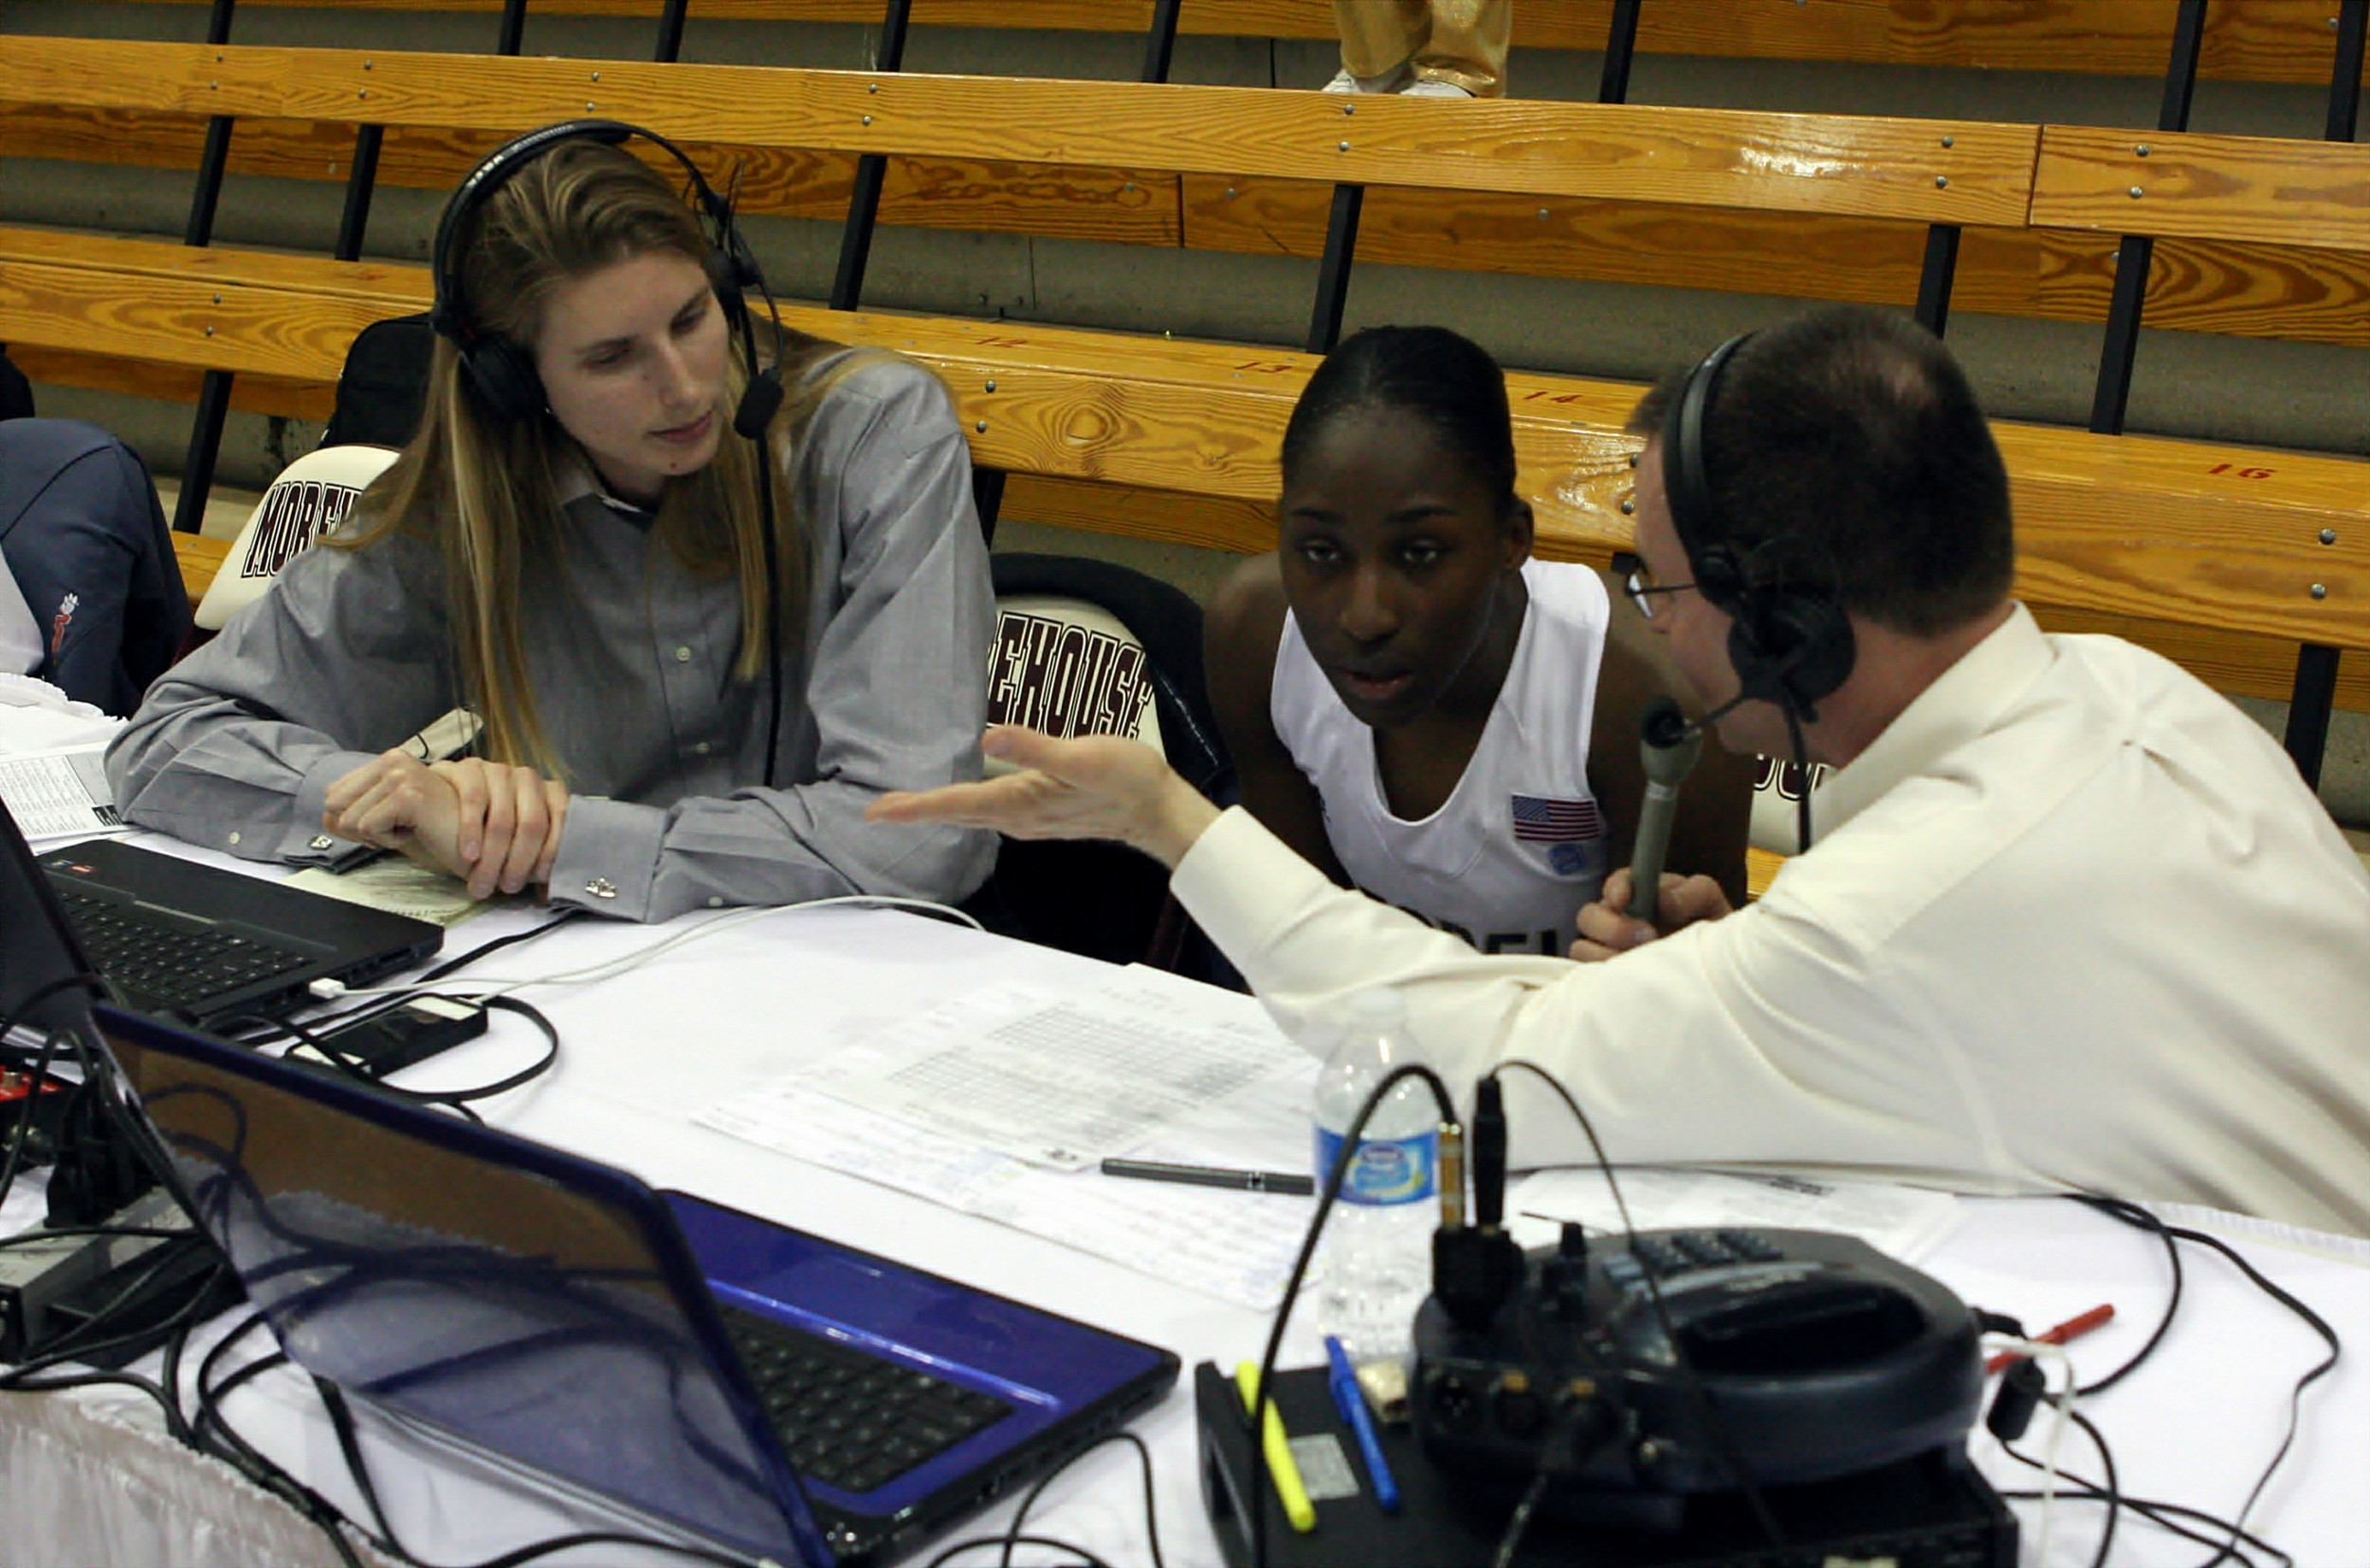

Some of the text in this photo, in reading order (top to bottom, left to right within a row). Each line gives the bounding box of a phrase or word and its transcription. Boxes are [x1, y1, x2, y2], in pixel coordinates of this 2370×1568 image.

[1234, 361, 1291, 374] 13
[1522, 391, 1583, 404] 14
[2208, 464, 2278, 480] 16
[986, 611, 1153, 741] EHOUSE
